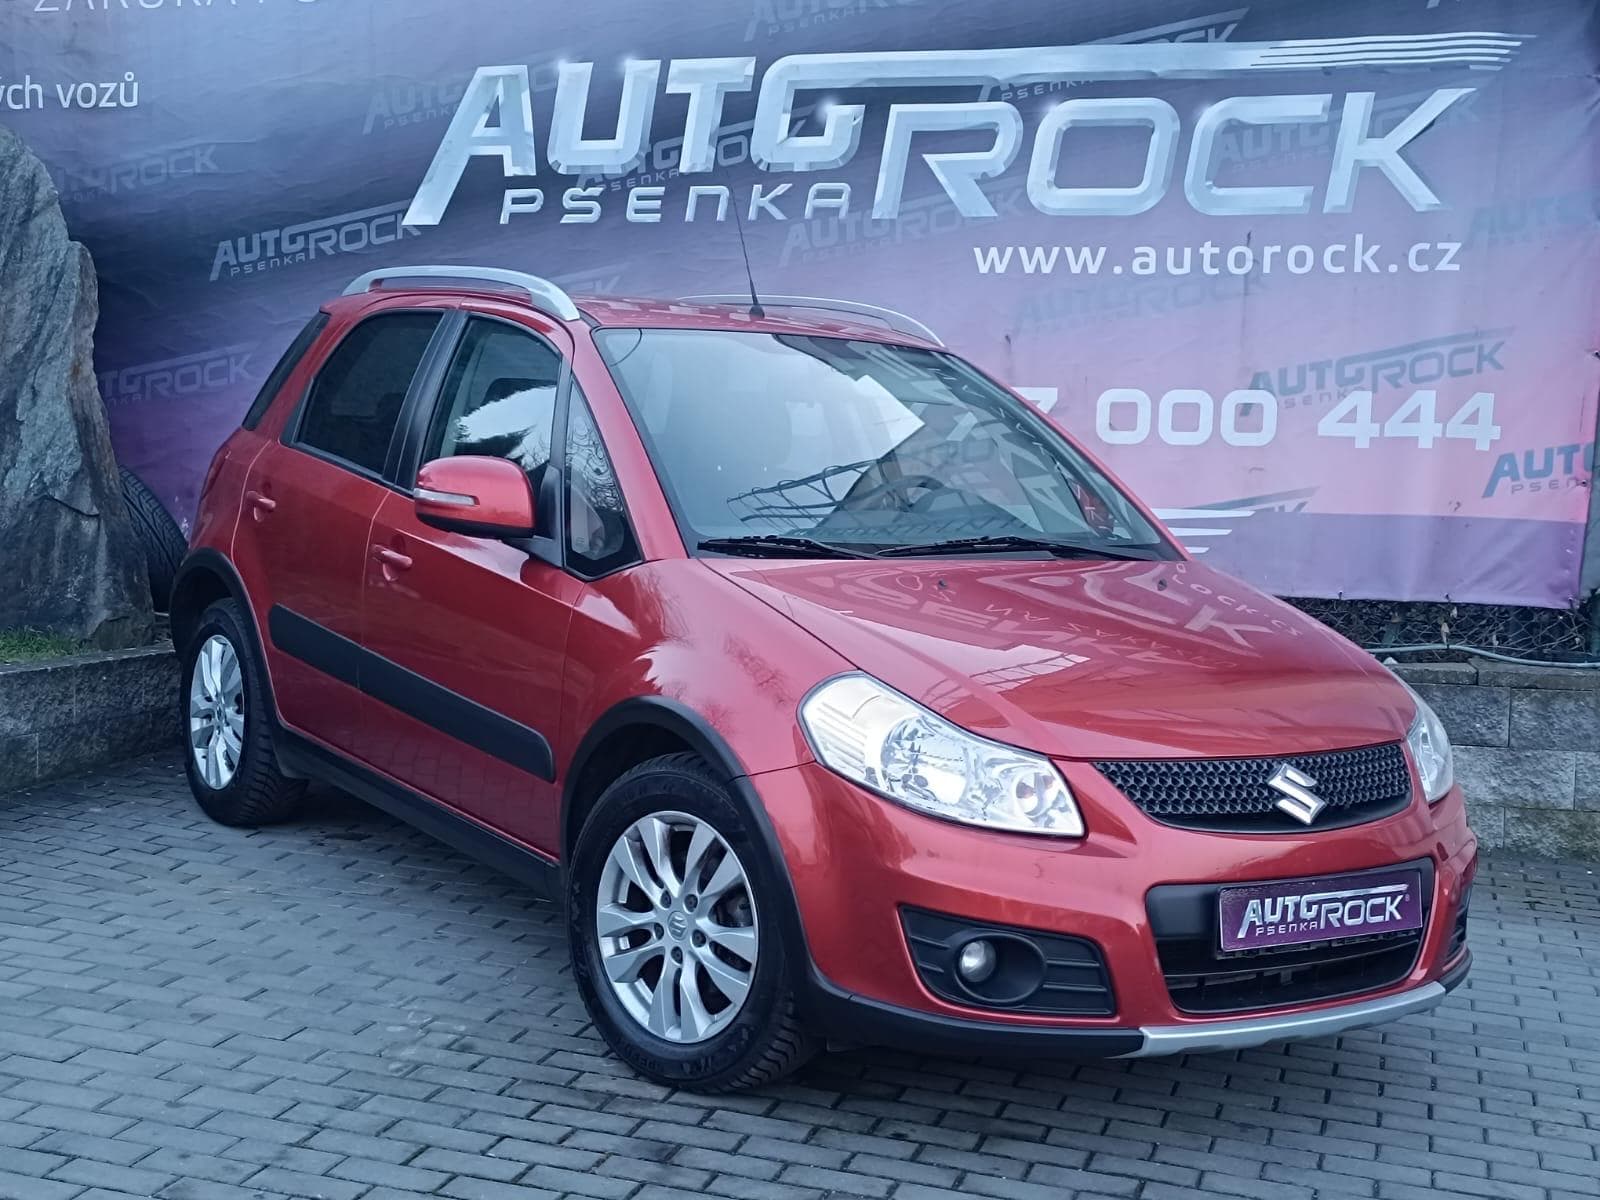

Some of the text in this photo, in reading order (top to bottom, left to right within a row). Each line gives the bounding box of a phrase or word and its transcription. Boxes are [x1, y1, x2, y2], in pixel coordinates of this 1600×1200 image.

[56, 71, 139, 109] vozů
[973, 233, 1463, 276] www.autorock.cz
[1096, 388, 1278, 447] 000
[1317, 389, 1501, 451] 444
